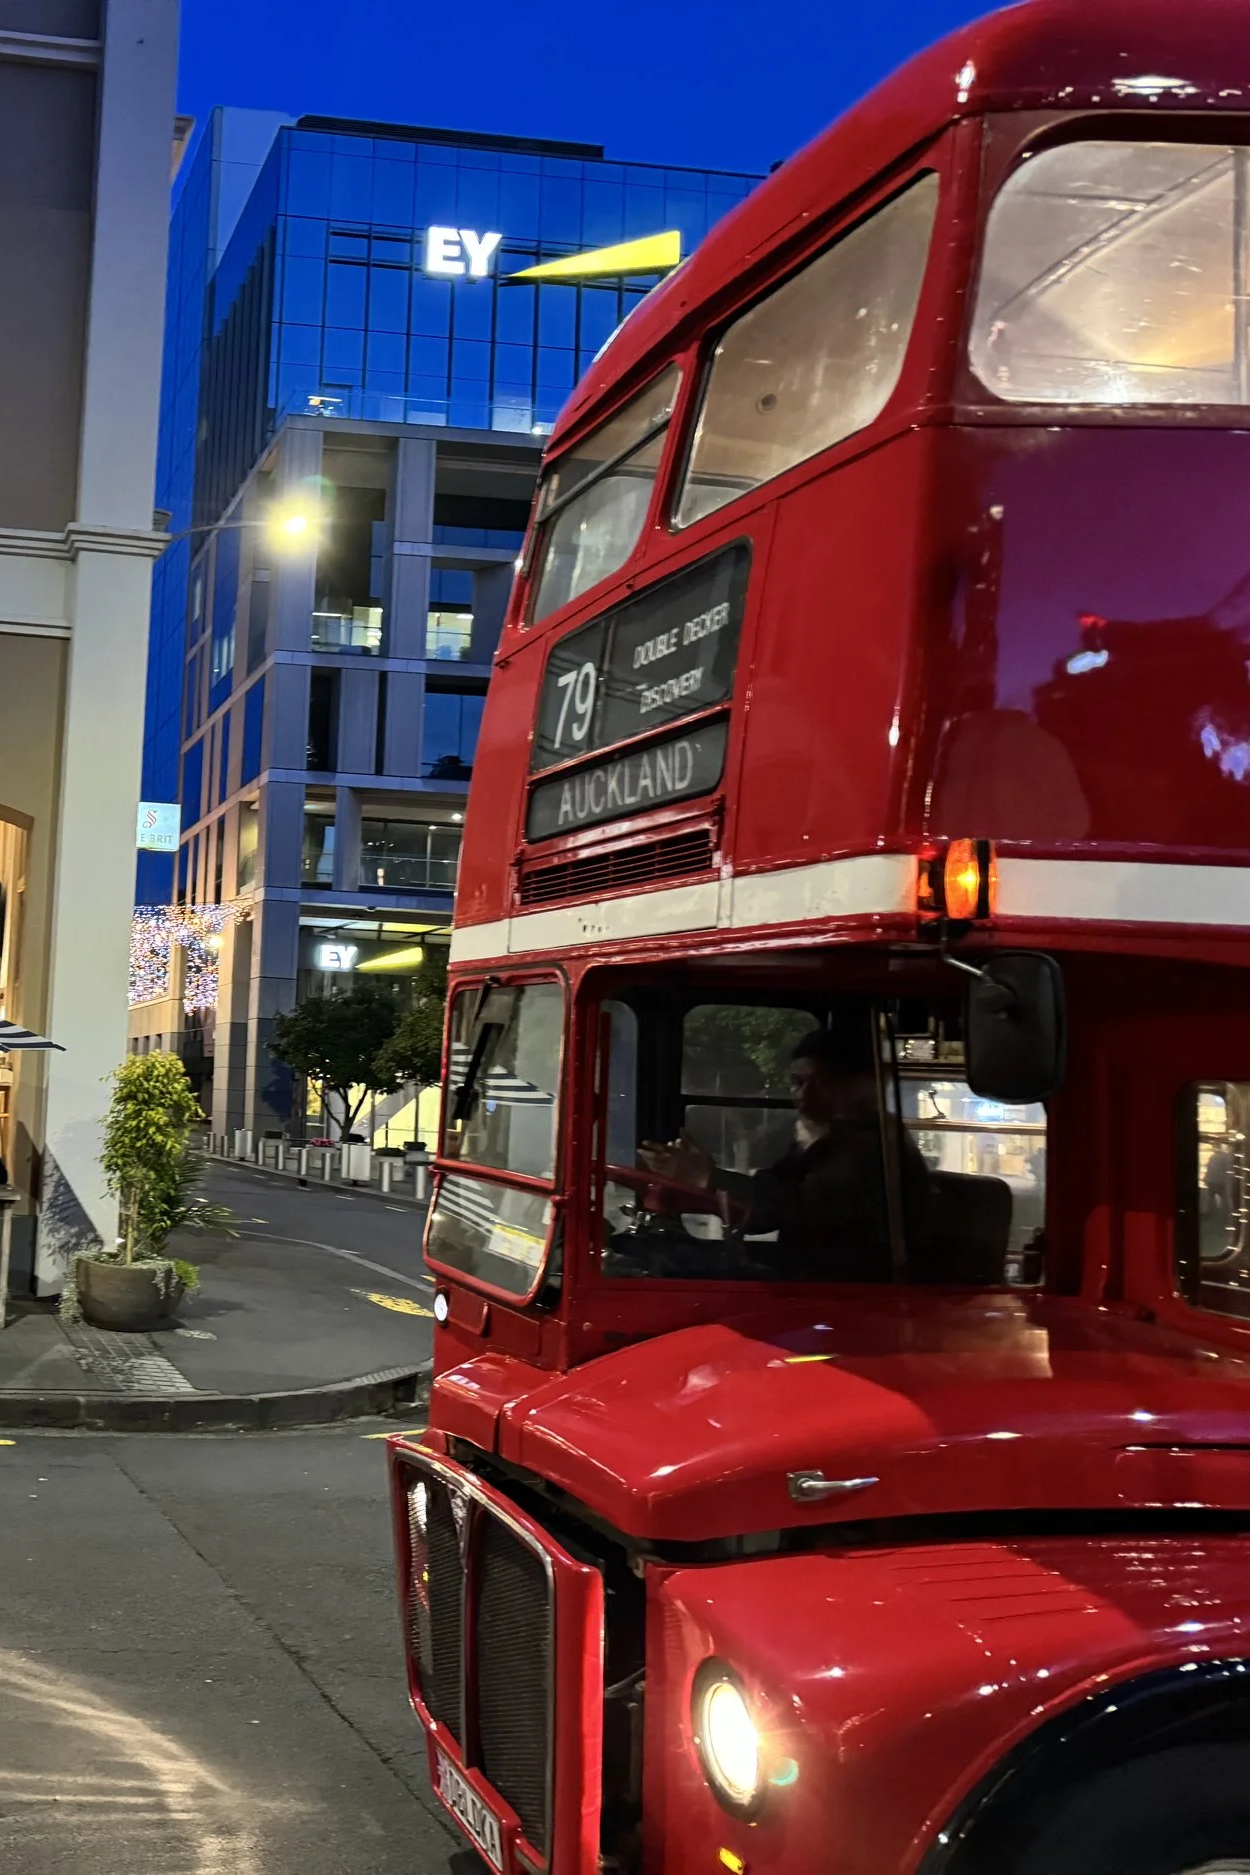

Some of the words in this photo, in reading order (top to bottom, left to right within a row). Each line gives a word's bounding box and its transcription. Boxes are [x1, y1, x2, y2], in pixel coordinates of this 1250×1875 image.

[427, 226, 502, 276] EY
[633, 627, 680, 669] DOUBLE
[683, 602, 730, 645] DECKER
[554, 662, 596, 749] 79
[639, 667, 704, 714] DISCOVERY
[558, 741, 693, 825] AUCKLAND
[150, 834, 174, 844] BRIT
[319, 944, 359, 972] EY
